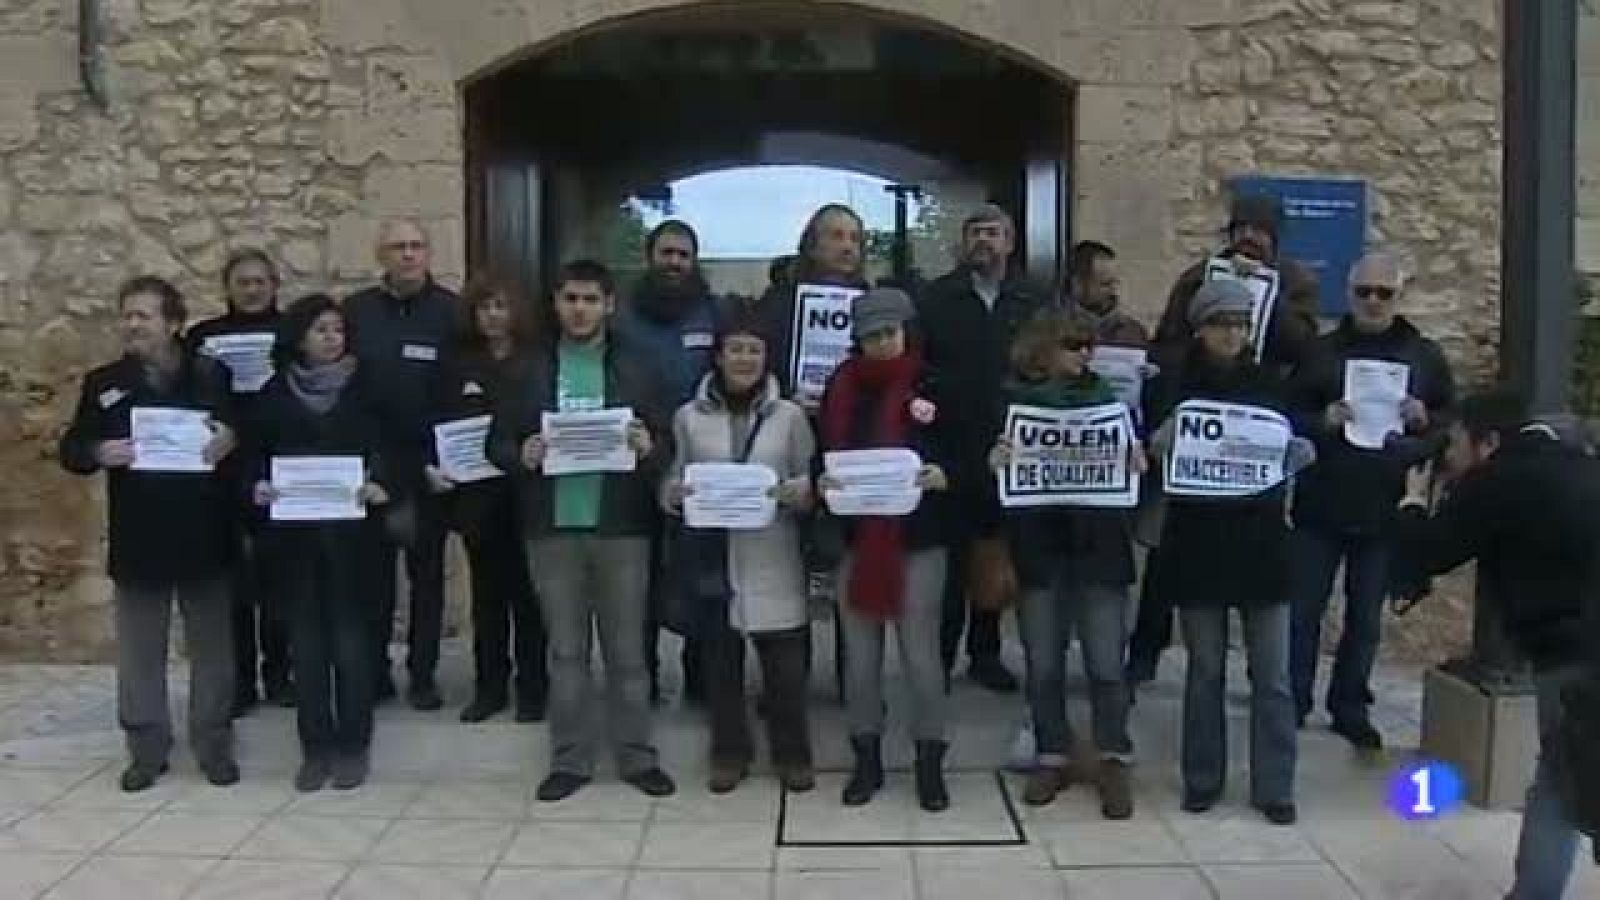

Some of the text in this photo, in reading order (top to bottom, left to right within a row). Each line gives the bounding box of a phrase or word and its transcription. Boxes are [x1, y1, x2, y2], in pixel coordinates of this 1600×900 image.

[809, 309, 849, 330] NO
[1019, 425, 1119, 450] VOLEM
[1179, 415, 1223, 441] NO
[1016, 464, 1039, 486] DE
